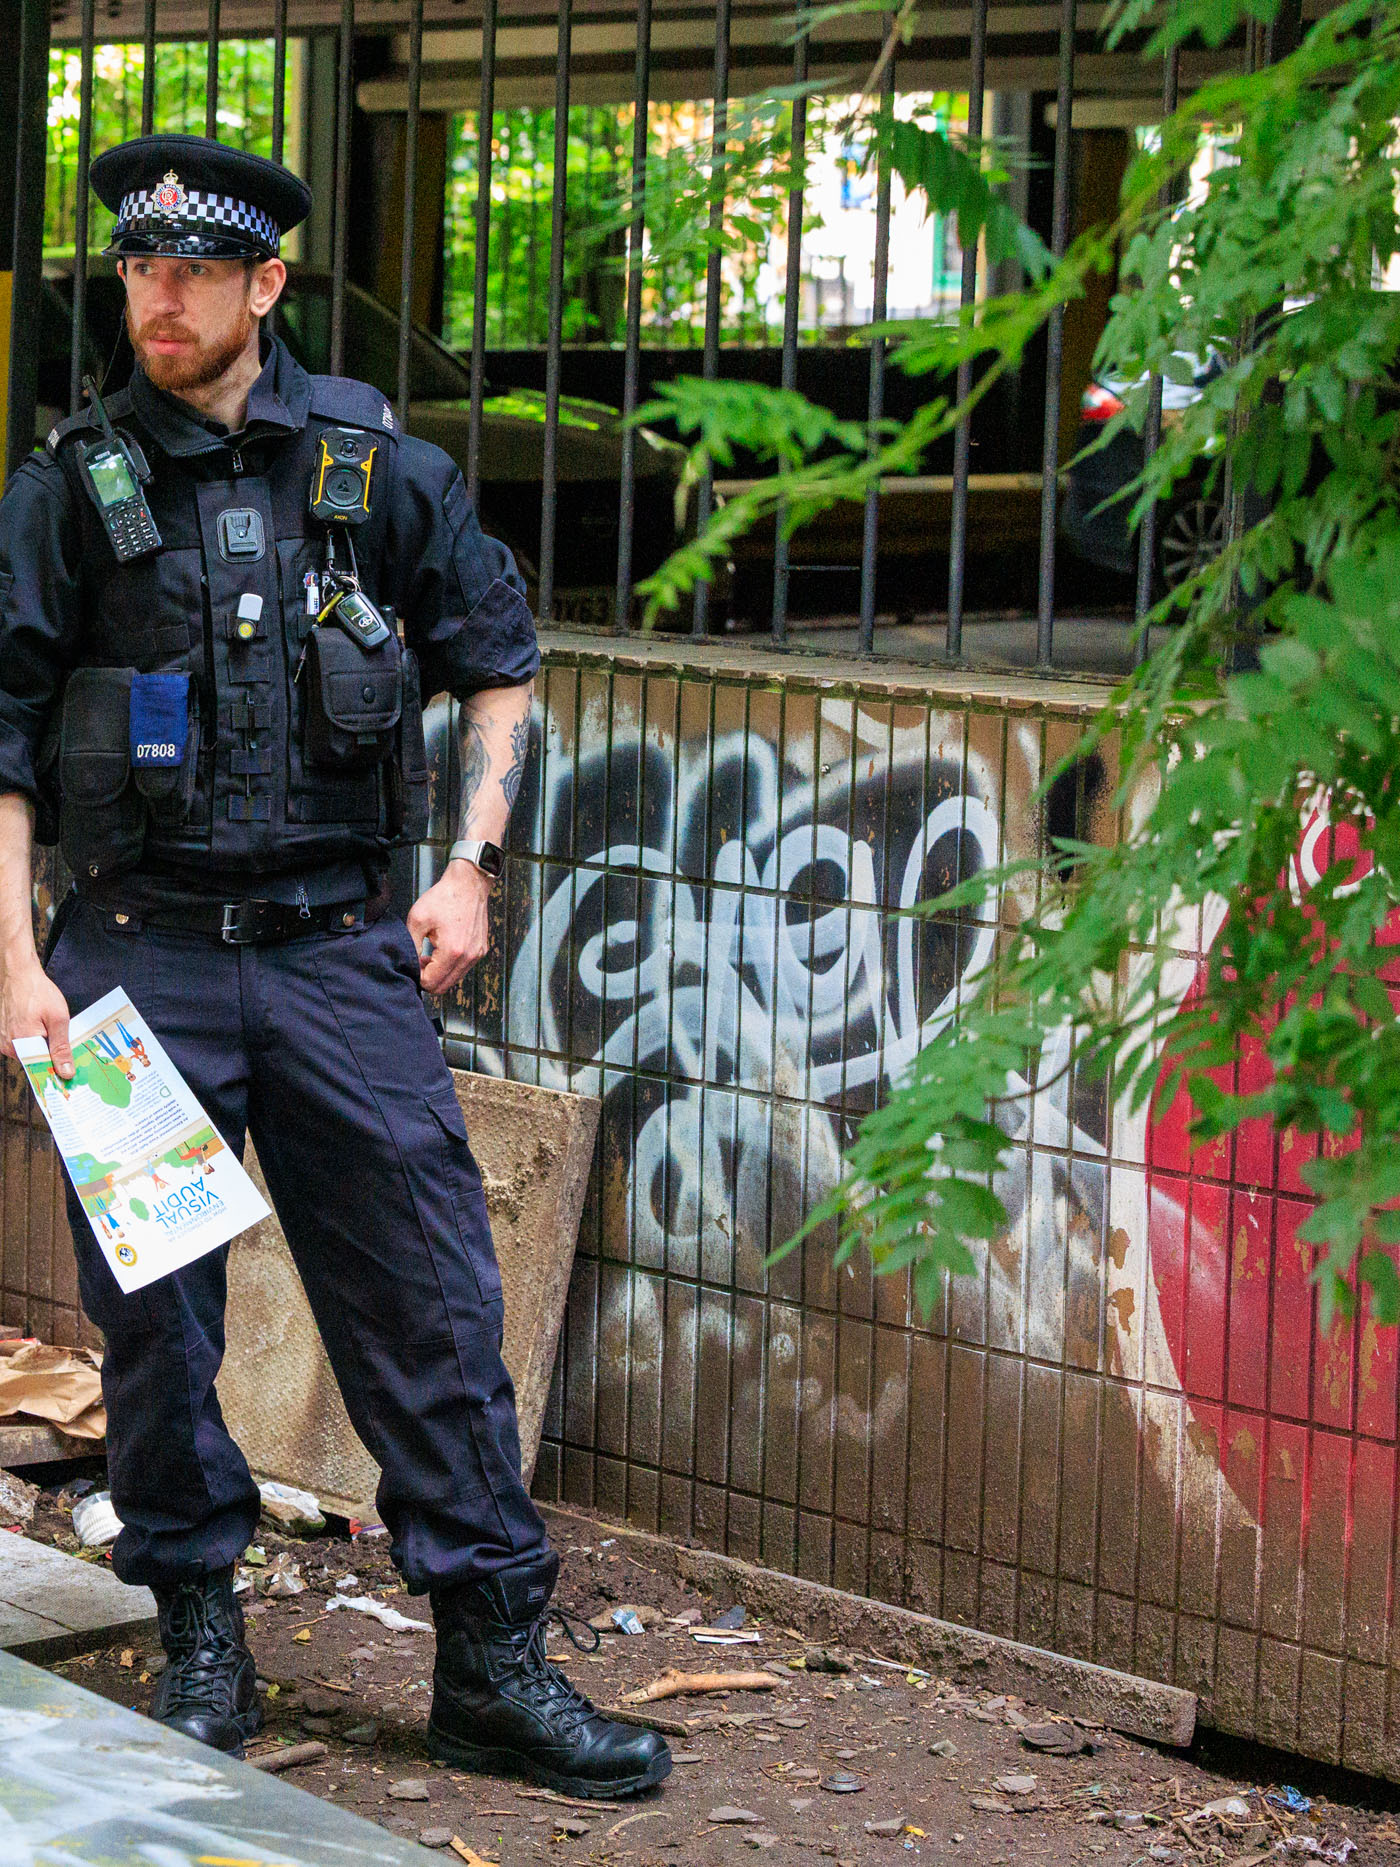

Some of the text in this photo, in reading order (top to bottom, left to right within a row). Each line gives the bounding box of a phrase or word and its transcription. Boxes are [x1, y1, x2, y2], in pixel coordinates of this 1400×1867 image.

[136, 743, 176, 758] 07808
[153, 1176, 204, 1218] AUDIT
[155, 1190, 219, 1228] VISUAL
